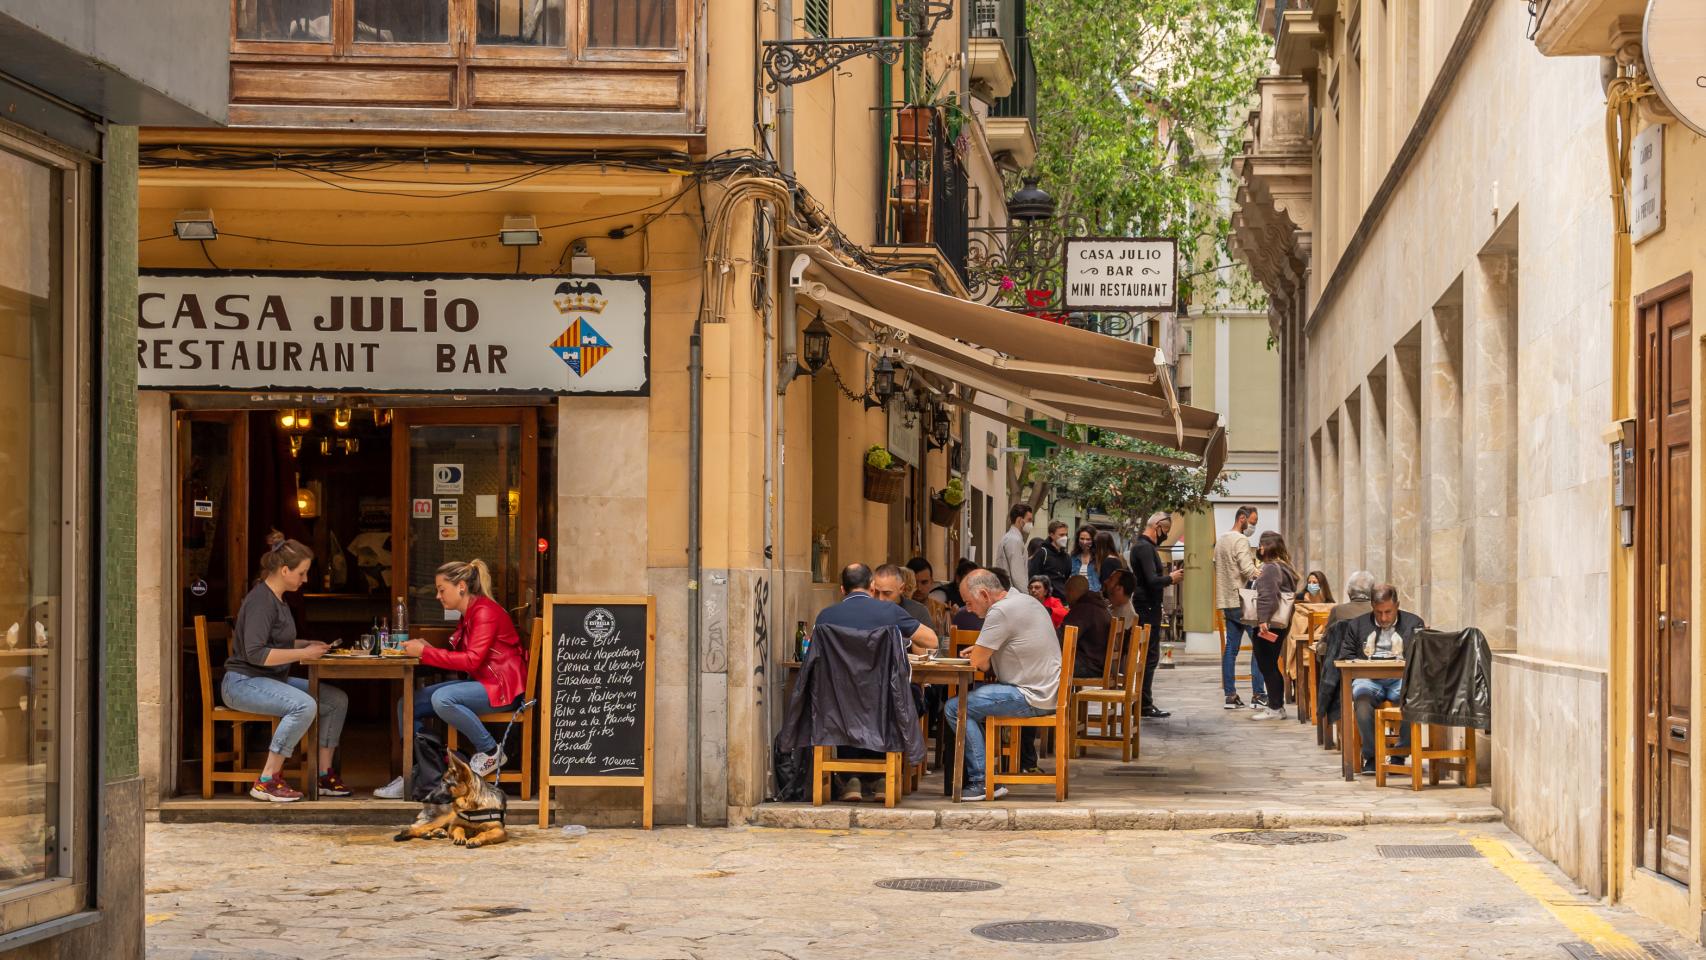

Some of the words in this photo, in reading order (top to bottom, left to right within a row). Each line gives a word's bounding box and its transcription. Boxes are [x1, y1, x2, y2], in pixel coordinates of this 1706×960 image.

[1080, 249, 1114, 260] CASA
[1119, 249, 1161, 260] JULIO
[1106, 266, 1134, 276] BAR
[1071, 283, 1095, 297] MINI
[1100, 283, 1168, 297] RESTAURANT
[138, 292, 292, 331] CASA
[436, 343, 508, 374] BAR
[557, 647, 592, 661] Ravioli
[557, 662, 590, 673] Crema
[594, 661, 606, 672] de
[557, 673, 602, 685] Ensalada
[607, 670, 633, 685] Mixta
[555, 690, 581, 703] Frito
[553, 704, 575, 717] Pollo
[588, 704, 600, 714] las
[555, 718, 577, 727] Lomo
[590, 716, 600, 726] la
[554, 729, 586, 741] Huevos
[588, 726, 615, 742] fritos
